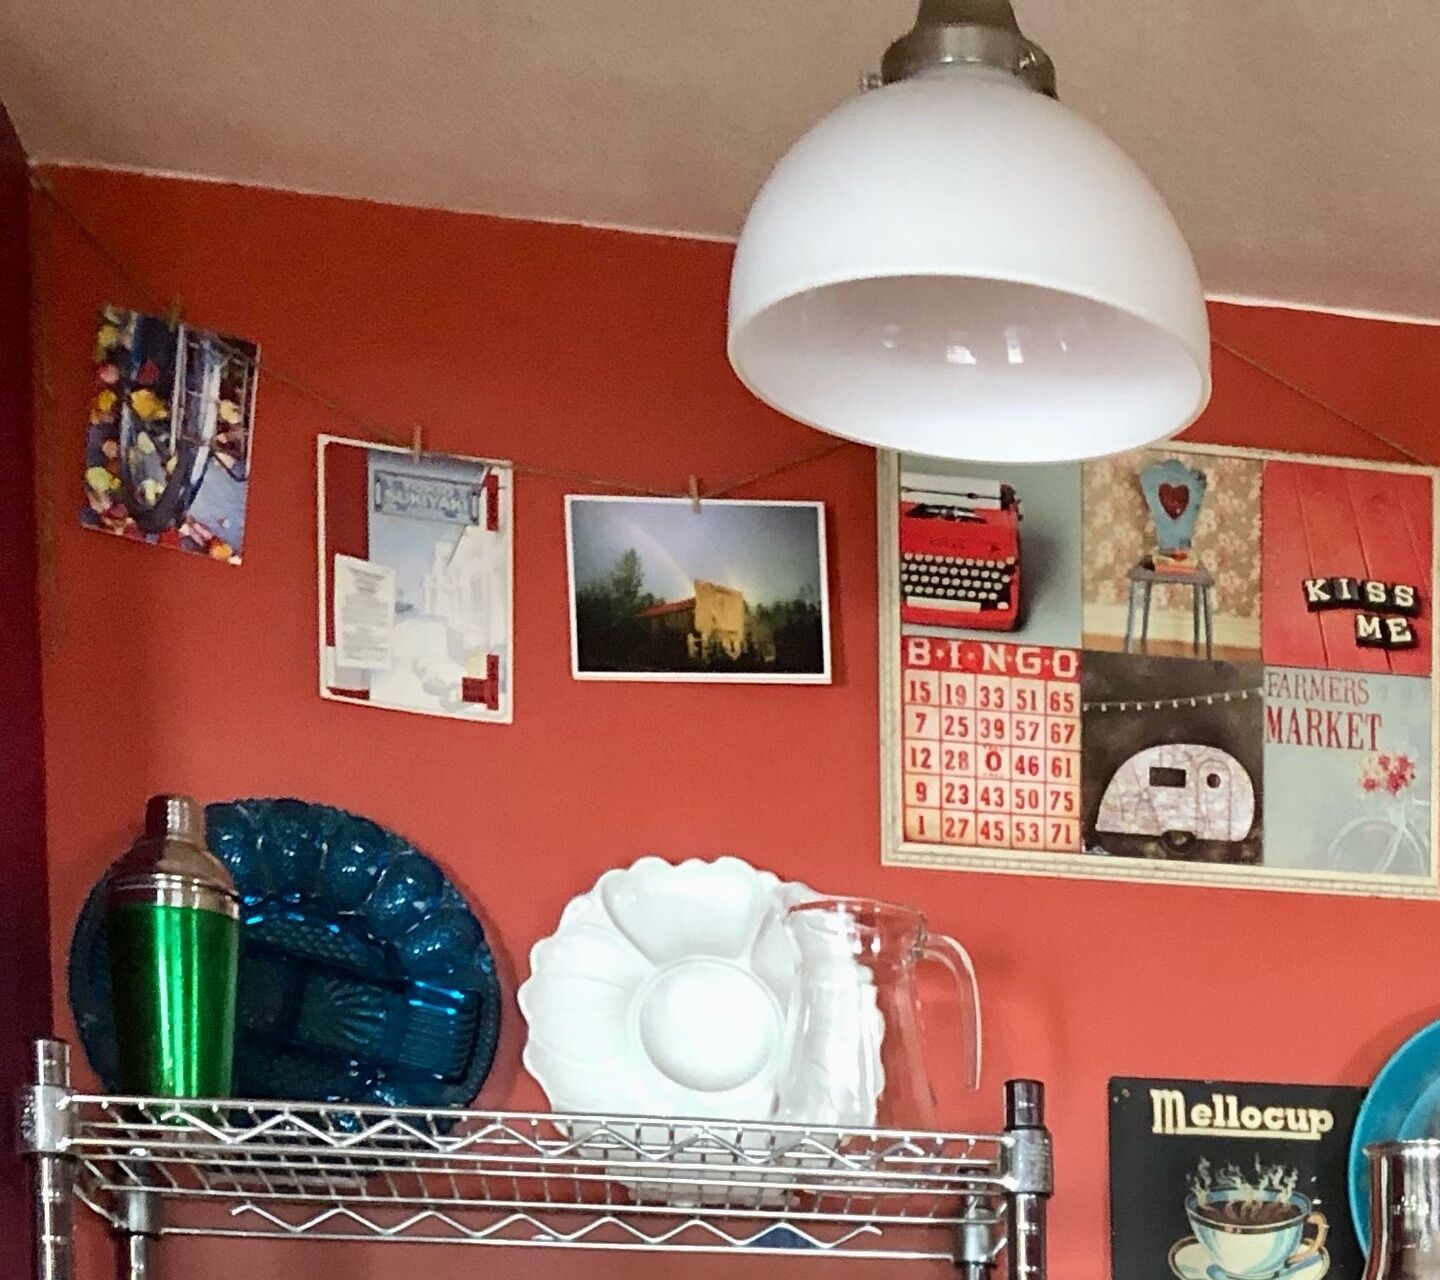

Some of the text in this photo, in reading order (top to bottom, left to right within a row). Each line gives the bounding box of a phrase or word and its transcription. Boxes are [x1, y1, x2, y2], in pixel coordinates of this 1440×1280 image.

[1304, 577, 1414, 607] KISS
[1356, 614, 1413, 643] ME
[910, 680, 1074, 713] 15 19 33 51 65
[1266, 671, 1370, 706] FARMERS
[915, 712, 1075, 744] 7 25 39 57 67
[1266, 705, 1382, 751] MARKET
[911, 747, 932, 769] 12
[944, 750, 969, 771] 28
[1015, 754, 1039, 777] 46
[1051, 756, 1072, 778] 61
[915, 781, 1074, 812] 9 23 43 50 75
[918, 815, 1072, 845] 1 27 45 53 71
[1150, 1088, 1334, 1140] Mellocup
